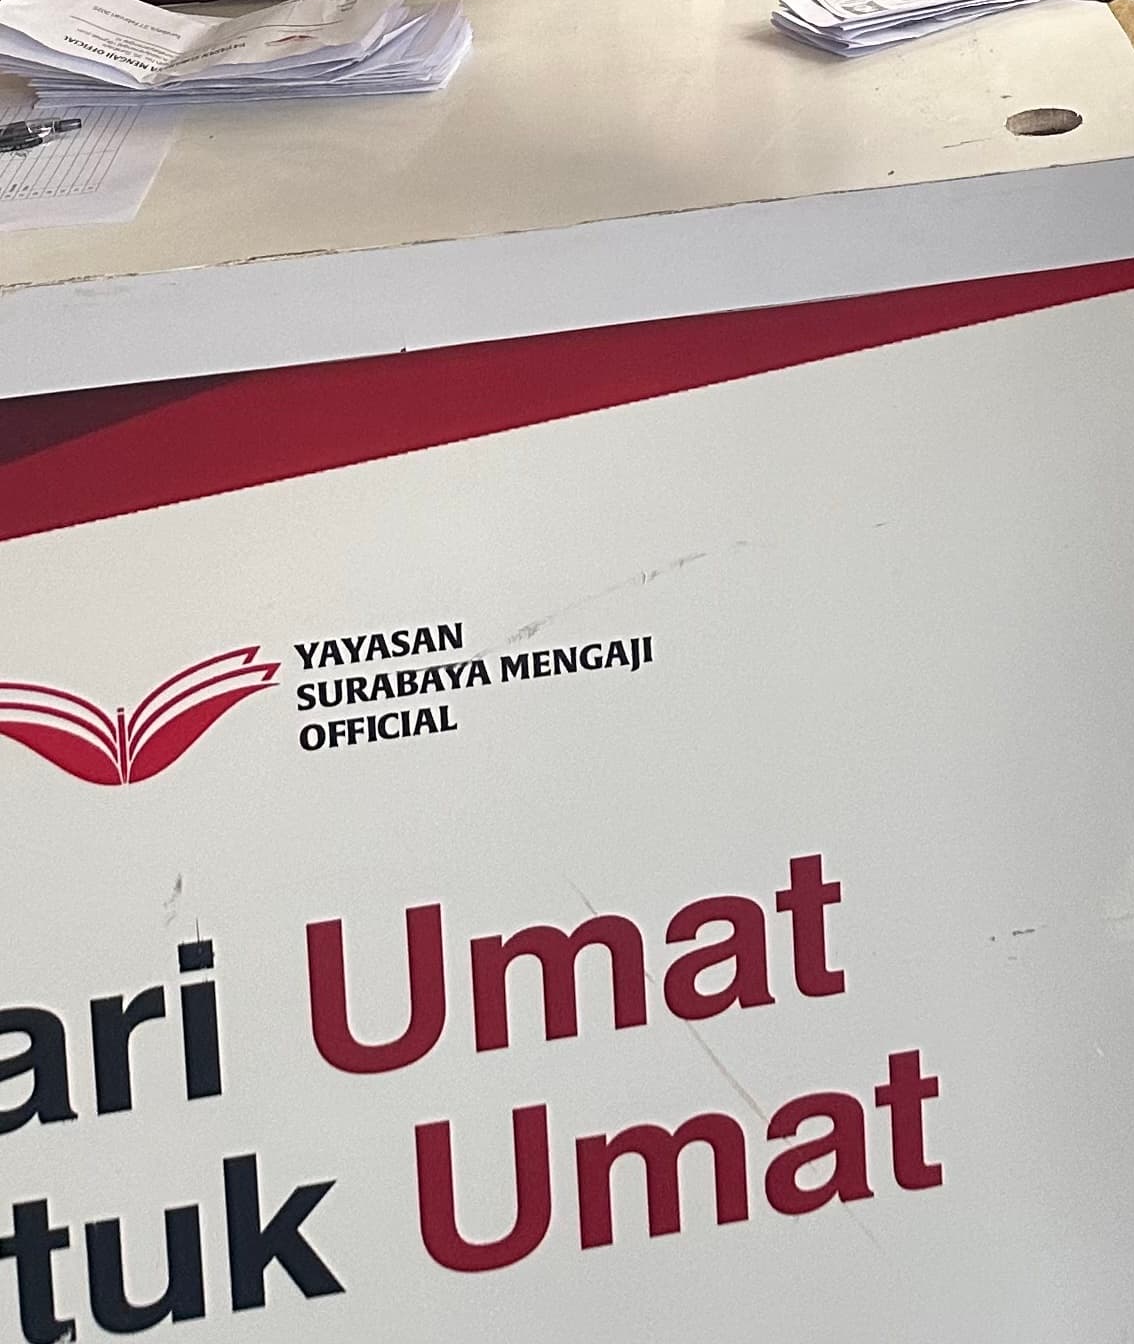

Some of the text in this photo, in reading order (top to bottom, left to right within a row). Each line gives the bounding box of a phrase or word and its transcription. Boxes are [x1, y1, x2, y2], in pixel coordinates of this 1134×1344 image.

[293, 622, 464, 670] YAYASAN
[296, 635, 654, 711] SURABAYA MENGAJI
[298, 705, 459, 752] OFFICIAL
[0, 853, 846, 1136] ari Umat
[0, 1049, 944, 1344] tuk Umat
